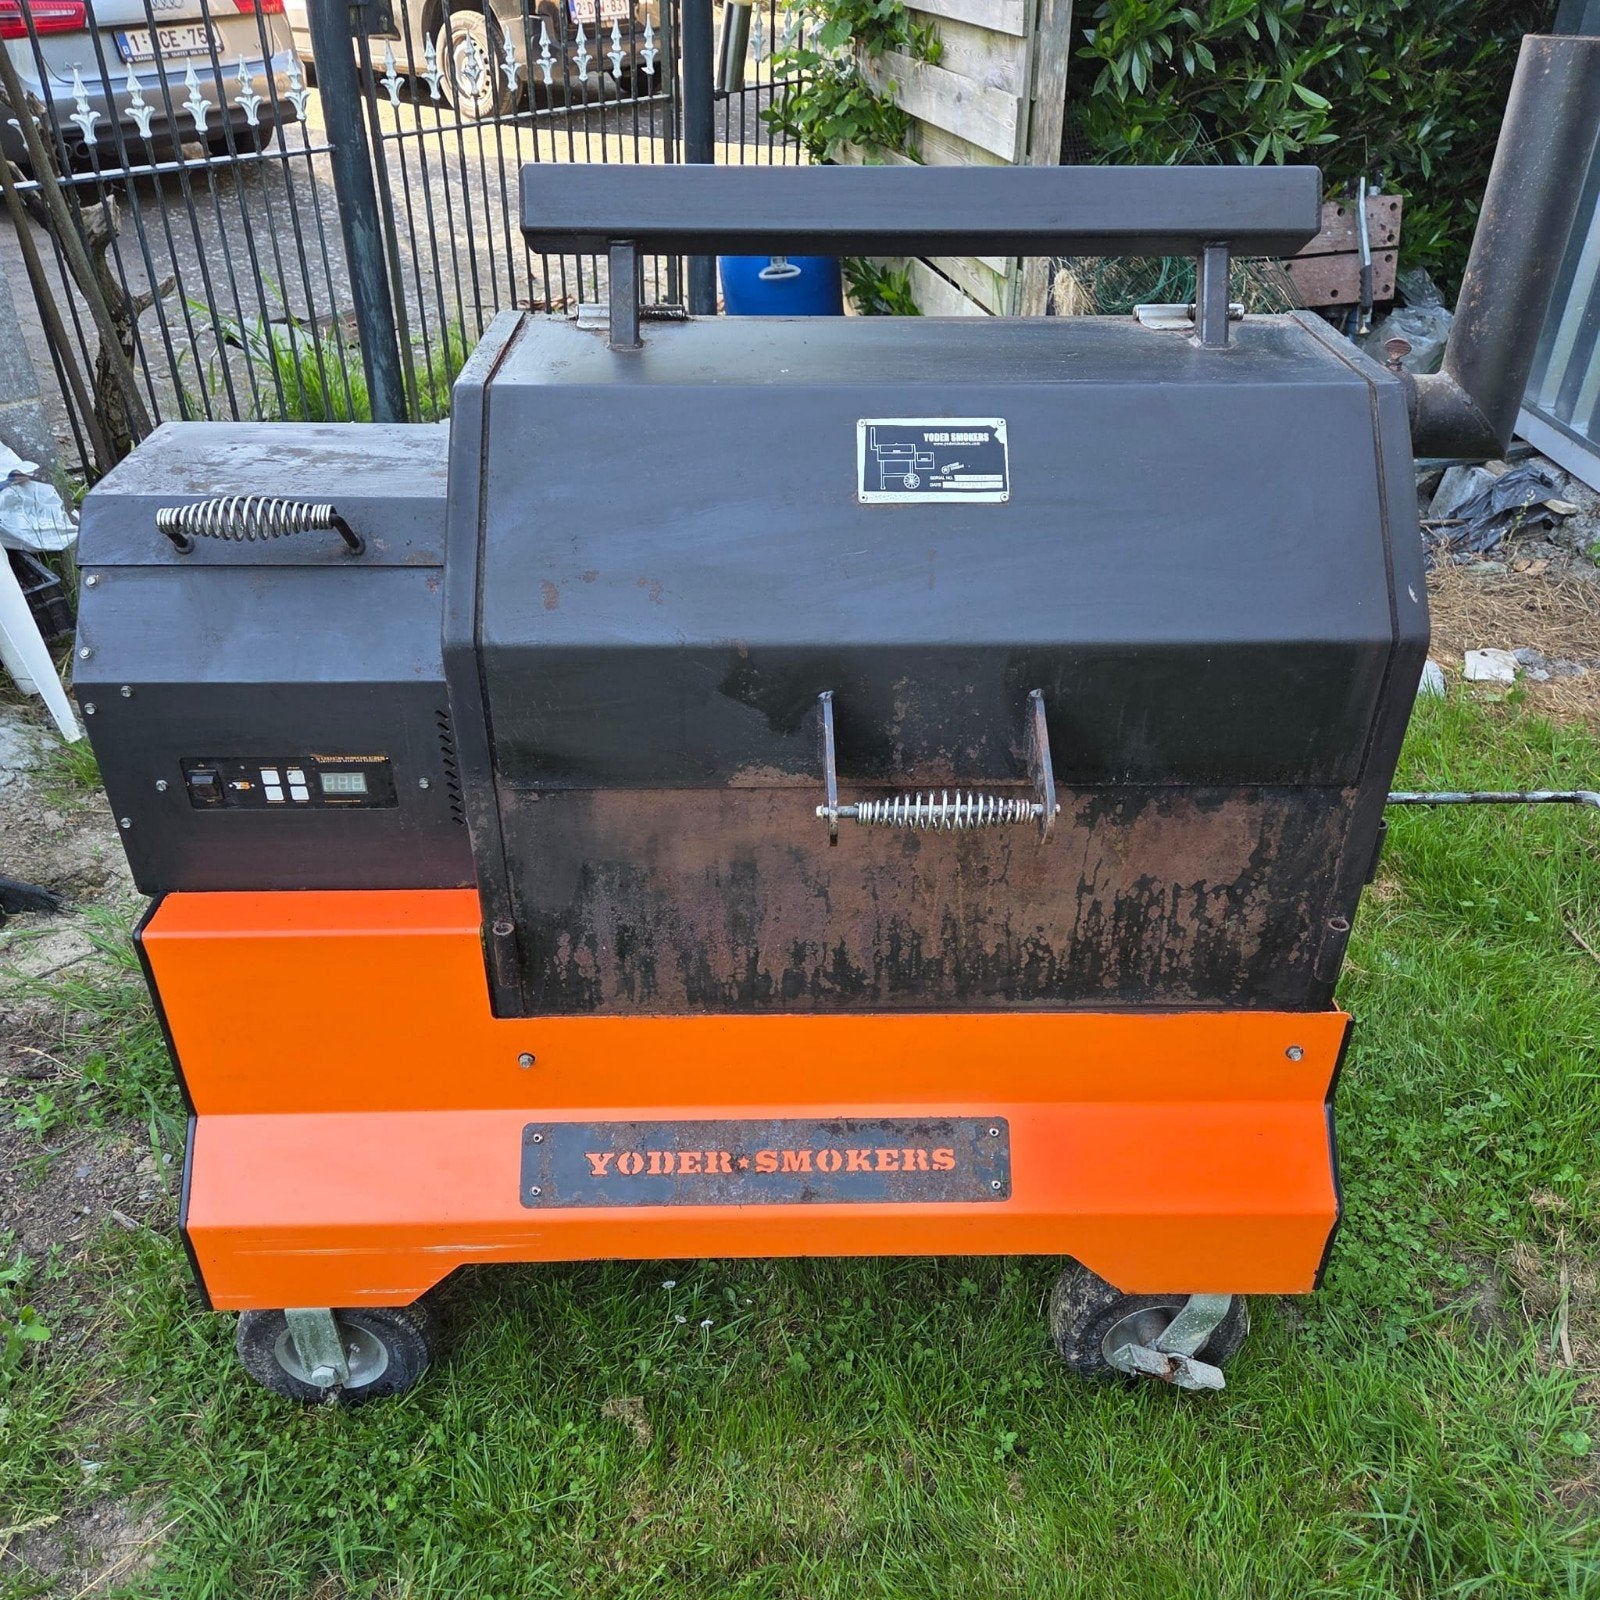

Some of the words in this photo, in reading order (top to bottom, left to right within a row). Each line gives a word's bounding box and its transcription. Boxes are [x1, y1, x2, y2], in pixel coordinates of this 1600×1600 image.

[924, 433, 950, 442] YODER
[950, 433, 989, 442] SMOKERS
[584, 1151, 733, 1176] YODER
[755, 1148, 956, 1173] SMOKERS
